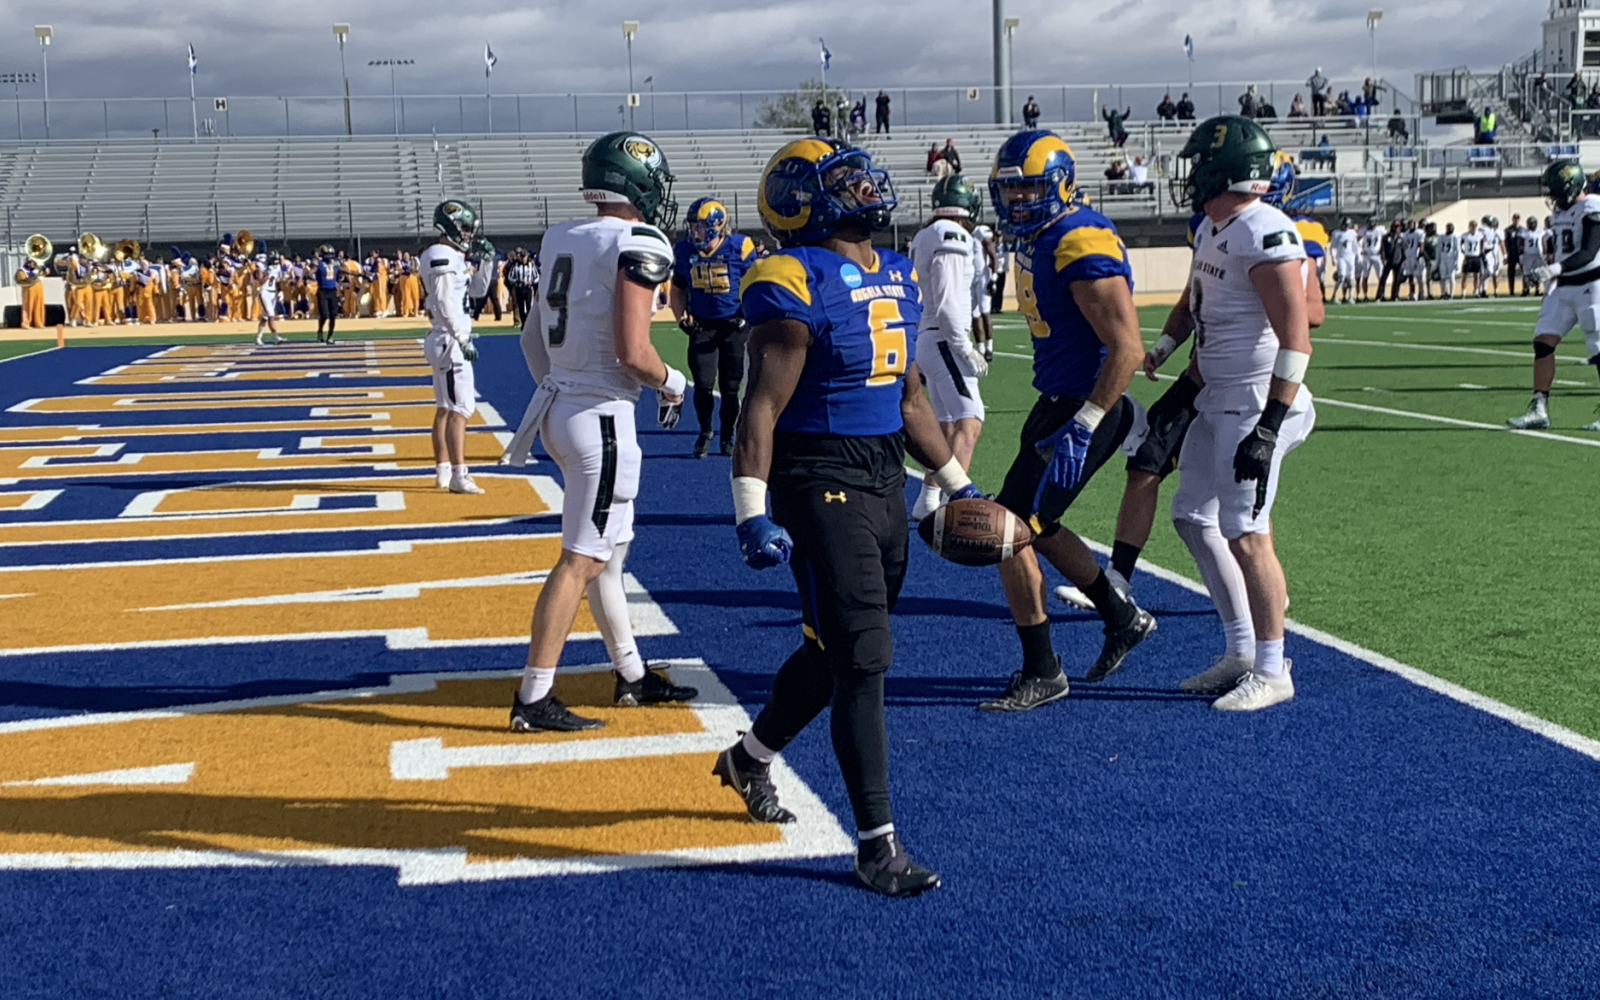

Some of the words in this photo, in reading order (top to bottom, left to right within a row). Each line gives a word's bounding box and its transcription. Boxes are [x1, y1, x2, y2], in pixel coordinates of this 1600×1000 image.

[215, 99, 226, 110] H
[969, 88, 977, 99] J
[1210, 124, 1228, 149] 3
[690, 263, 731, 294] 45
[1202, 261, 1226, 280] STATE
[546, 253, 574, 348] 9
[865, 298, 908, 387] 6
